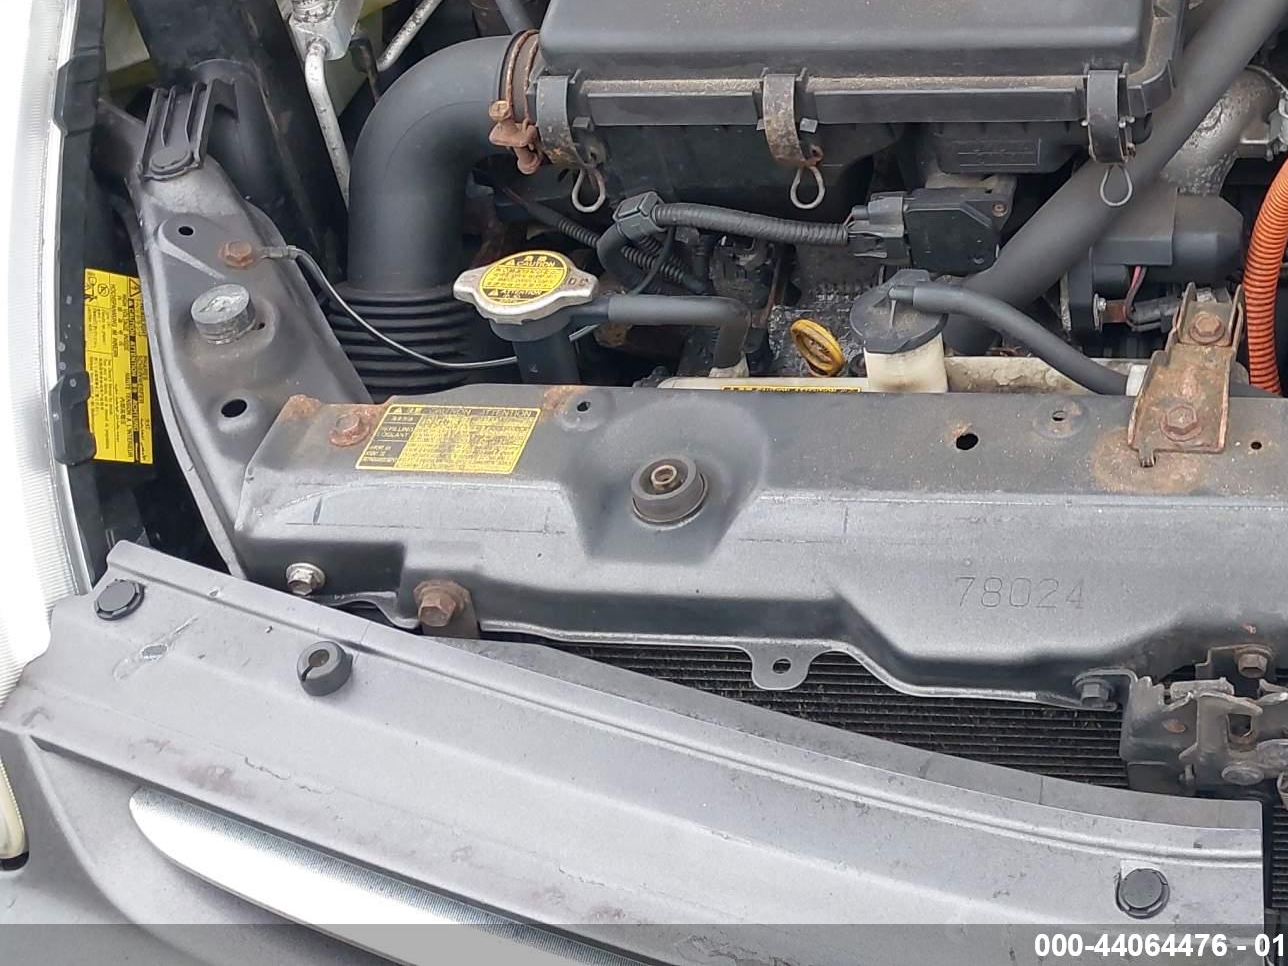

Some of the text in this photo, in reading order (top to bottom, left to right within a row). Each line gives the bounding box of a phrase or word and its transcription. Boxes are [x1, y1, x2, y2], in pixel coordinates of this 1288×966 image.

[128, 307, 136, 336] CAUTION
[129, 340, 137, 377] ATTENTION
[955, 576, 1085, 610] 78024
